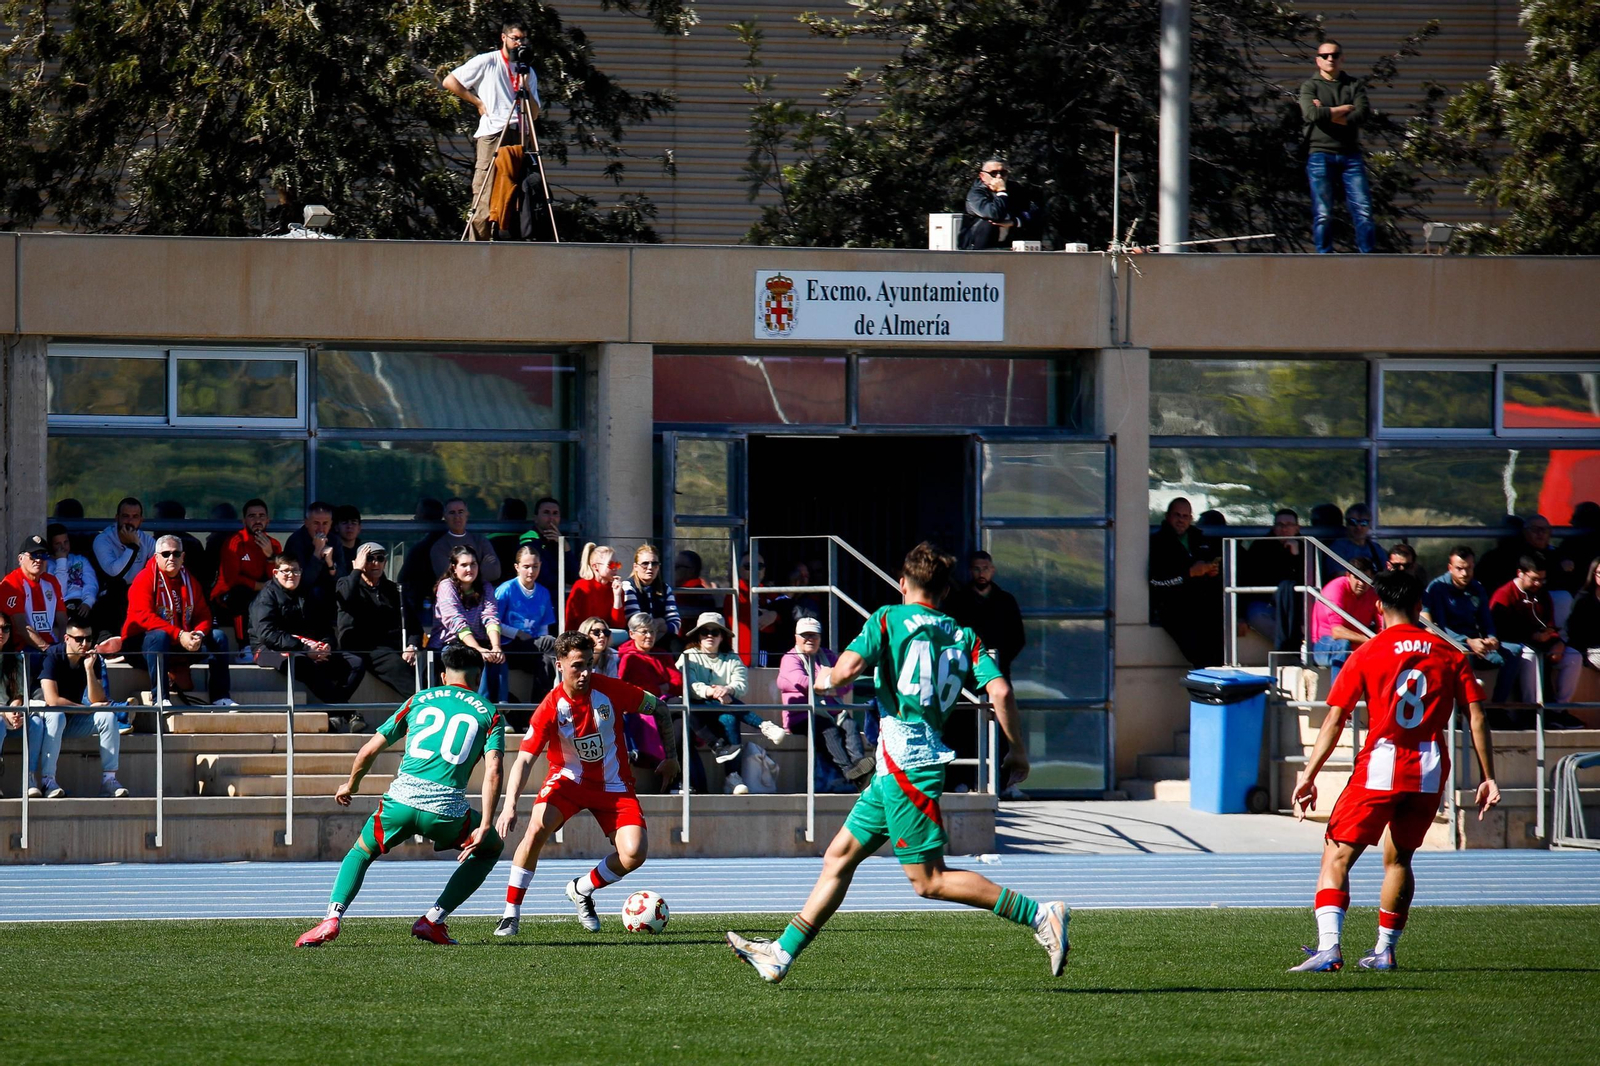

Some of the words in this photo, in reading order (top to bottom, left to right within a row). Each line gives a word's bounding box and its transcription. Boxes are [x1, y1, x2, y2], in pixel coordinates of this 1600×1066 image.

[806, 279, 871, 301] Excmo.
[876, 280, 999, 307] Ayuntamiento
[854, 313, 875, 335] de
[879, 313, 950, 336] Almería
[1394, 640, 1432, 655] JOAN
[897, 639, 968, 712] 46
[417, 689, 451, 703] PERE
[455, 691, 488, 714] HARO
[1396, 669, 1427, 729] 8
[409, 706, 479, 765] 20
[581, 740, 597, 750] DA
[583, 749, 598, 757] ZN
